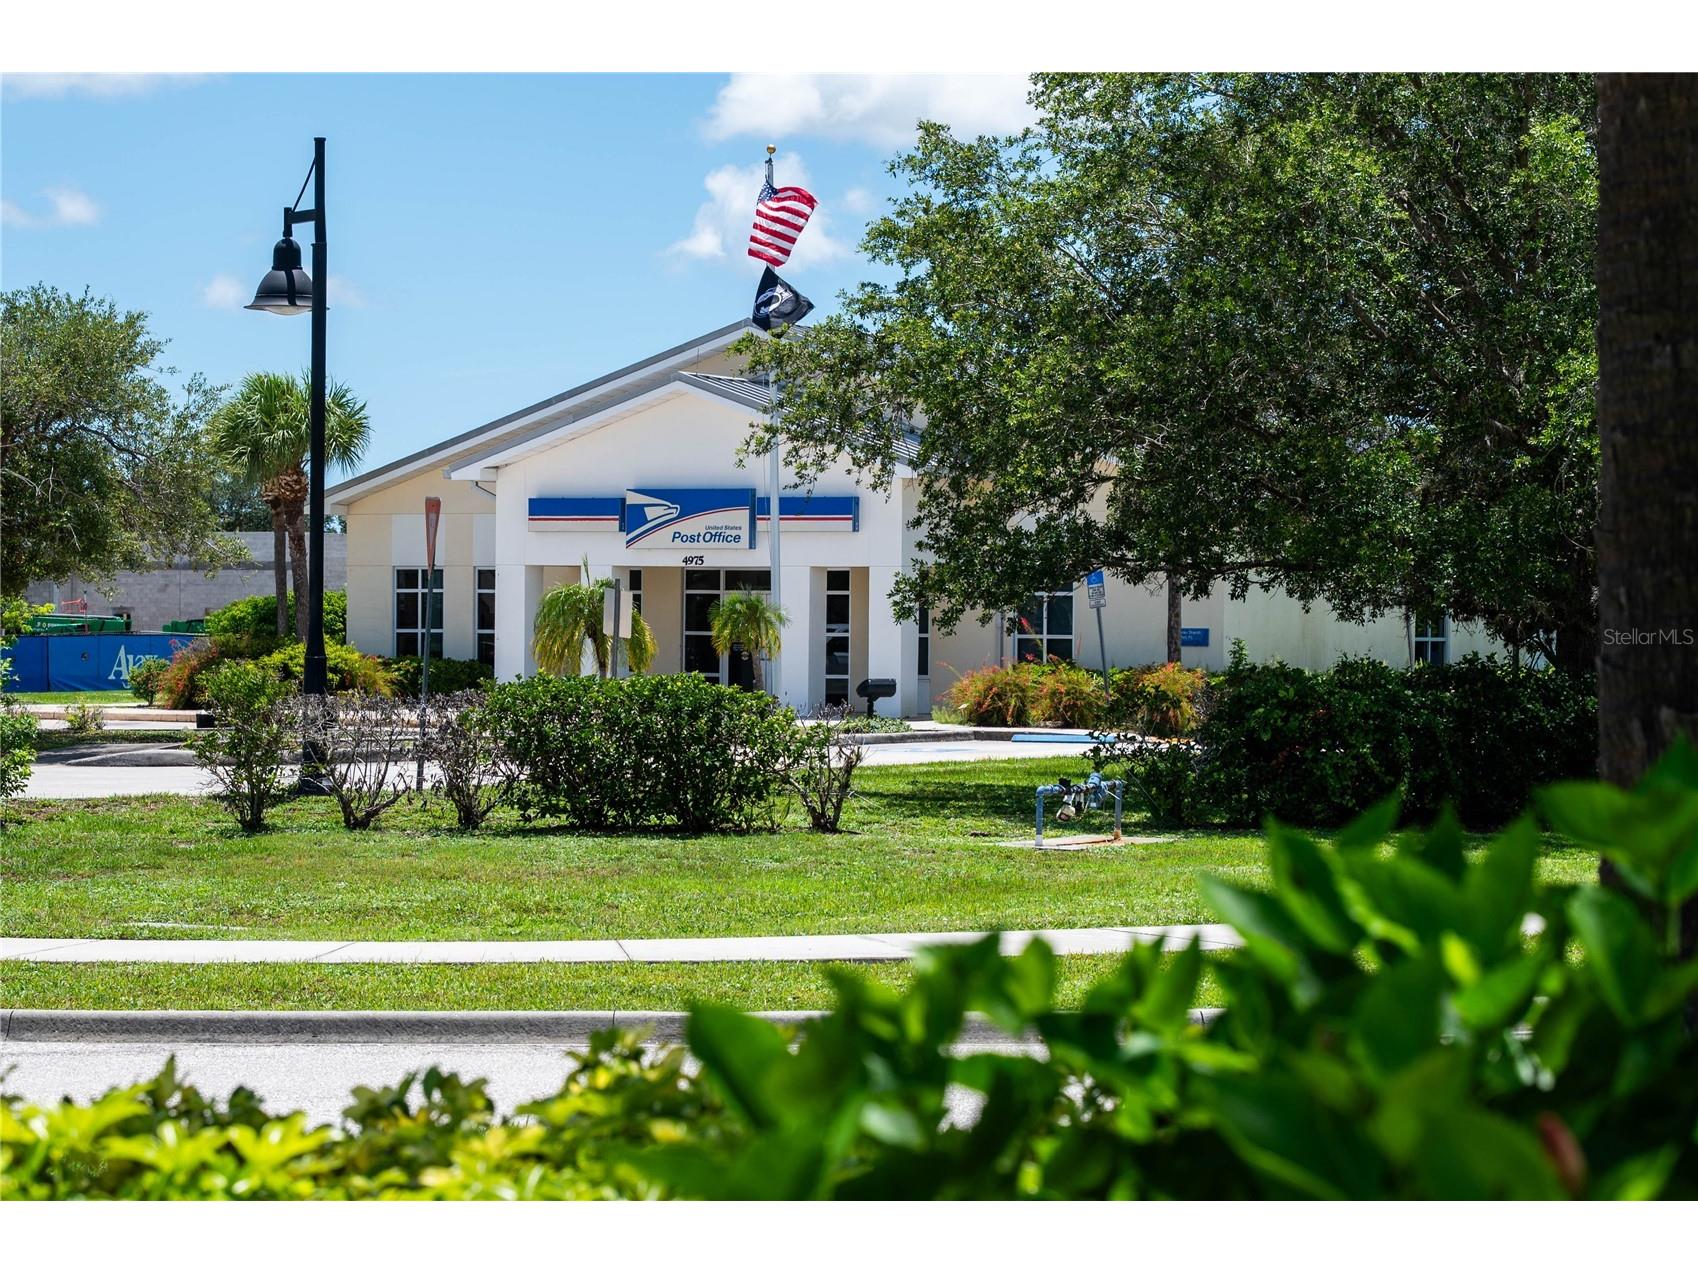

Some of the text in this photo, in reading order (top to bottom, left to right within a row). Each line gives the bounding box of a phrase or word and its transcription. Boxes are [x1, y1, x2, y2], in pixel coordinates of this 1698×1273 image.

[672, 531, 742, 544] Post Office
[682, 555, 705, 566] 4975
